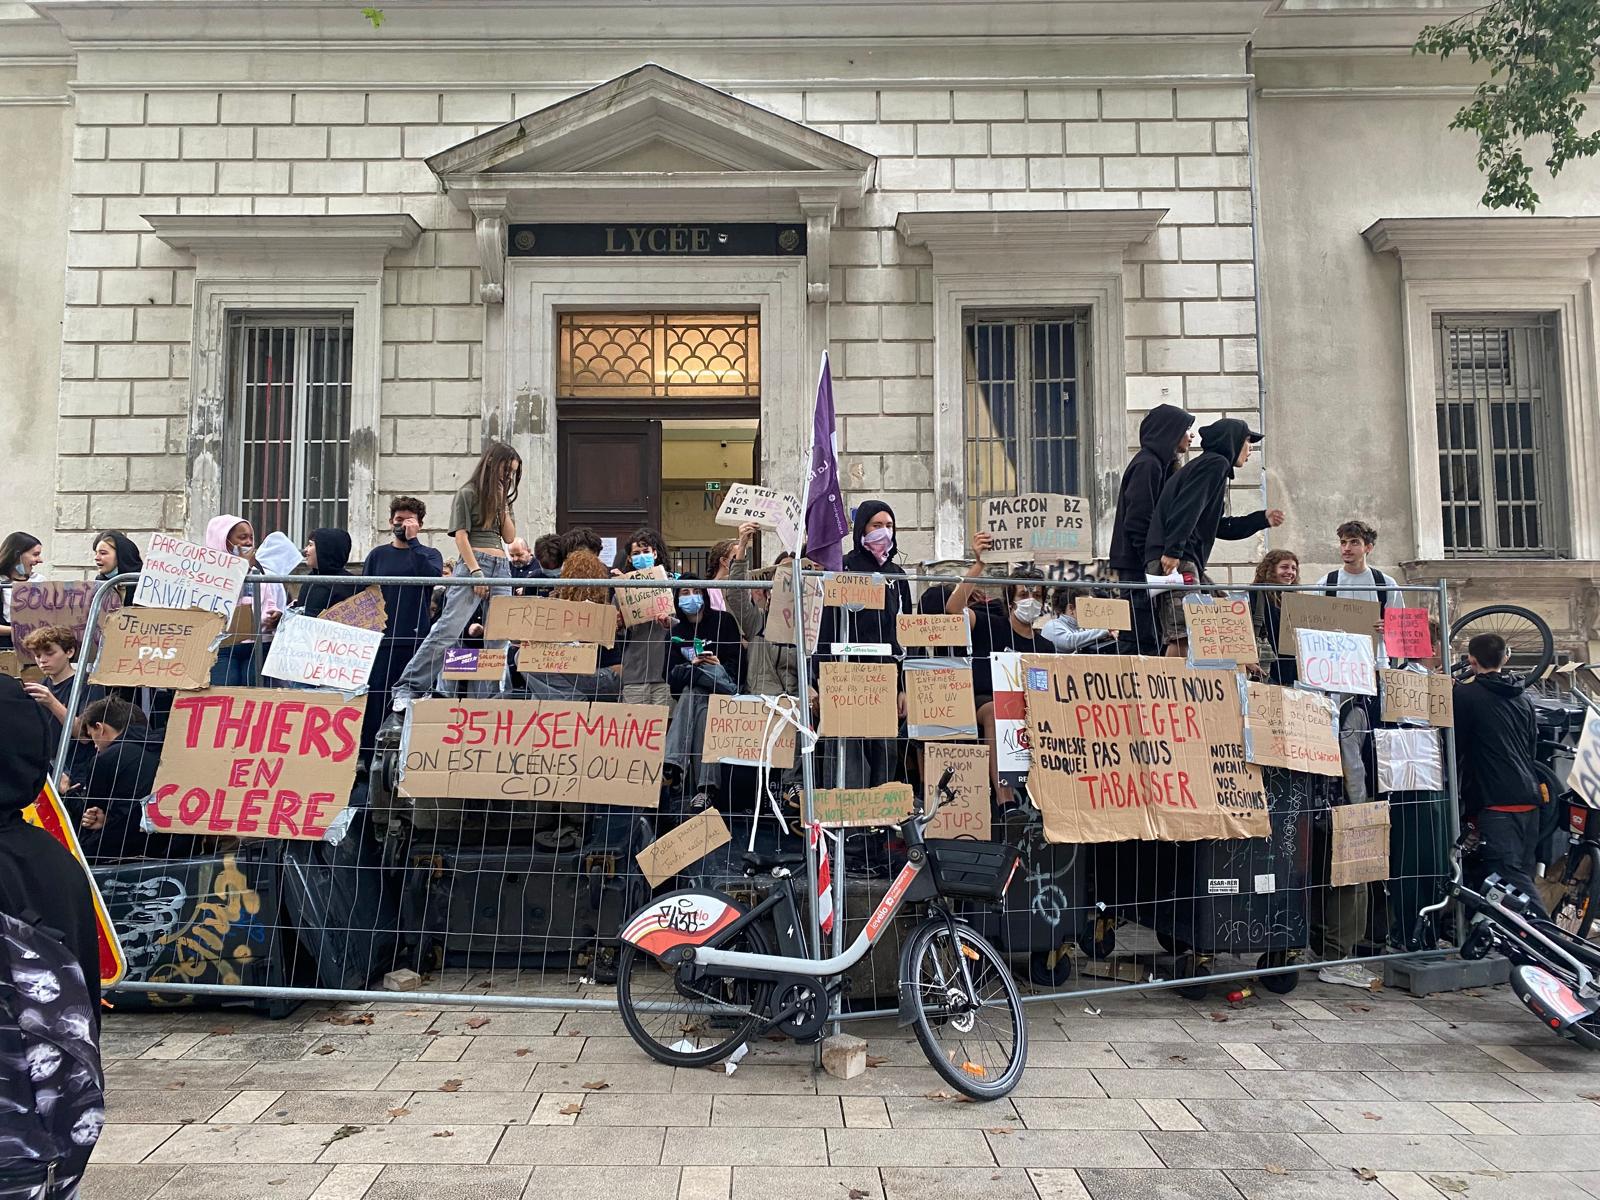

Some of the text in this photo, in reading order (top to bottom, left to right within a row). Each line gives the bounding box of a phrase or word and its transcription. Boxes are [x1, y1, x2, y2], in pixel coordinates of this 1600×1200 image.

[605, 224, 710, 252] LYCÉE
[729, 496, 750, 506] NOS
[735, 487, 748, 496] ÇA
[754, 488, 778, 499] VEUT
[725, 506, 739, 515] DE
[744, 508, 766, 519] NOS
[989, 497, 1081, 516] MACRON BZ
[988, 515, 1084, 532] TA PROF PAS
[151, 534, 241, 569] PARCOURSUP
[181, 558, 202, 573] OU
[836, 574, 869, 585] CONTRE
[828, 588, 837, 599] LE
[506, 605, 556, 631] FREE
[1189, 603, 1204, 615] LA
[118, 614, 194, 635] JEUNESSE
[1203, 625, 1247, 636] BAISER
[123, 634, 186, 649] FACHÉE
[1301, 632, 1358, 653] THIERS
[137, 646, 178, 660] PAS
[302, 662, 365, 685] DÉVORE
[1307, 656, 1370, 687] COLÈRE
[944, 692, 958, 702] UN
[1053, 672, 1079, 704] LA
[1084, 672, 1140, 701] POLICE
[1183, 677, 1225, 703] NOUS
[831, 693, 881, 709] POLICIER
[1385, 684, 1447, 715] RESPECTER
[923, 705, 957, 719] LUXE
[174, 695, 362, 763] THIERS
[710, 717, 767, 734] PARTOUT
[1038, 720, 1053, 734] LA
[1075, 702, 1201, 743] PROTEGER
[708, 735, 795, 751] JUSTICE ULLE
[1039, 737, 1087, 757] JEUNESSE
[1210, 744, 1244, 758] NOTRE
[1093, 739, 1172, 769] PAS NOUS
[228, 757, 285, 788] EN
[405, 747, 439, 772] ON
[448, 749, 492, 772] EST
[626, 759, 663, 786] EN
[1078, 771, 1198, 810] TABASSER
[1216, 777, 1237, 791] VOS
[146, 783, 336, 838] COLERE
[932, 812, 984, 831] STUPS
